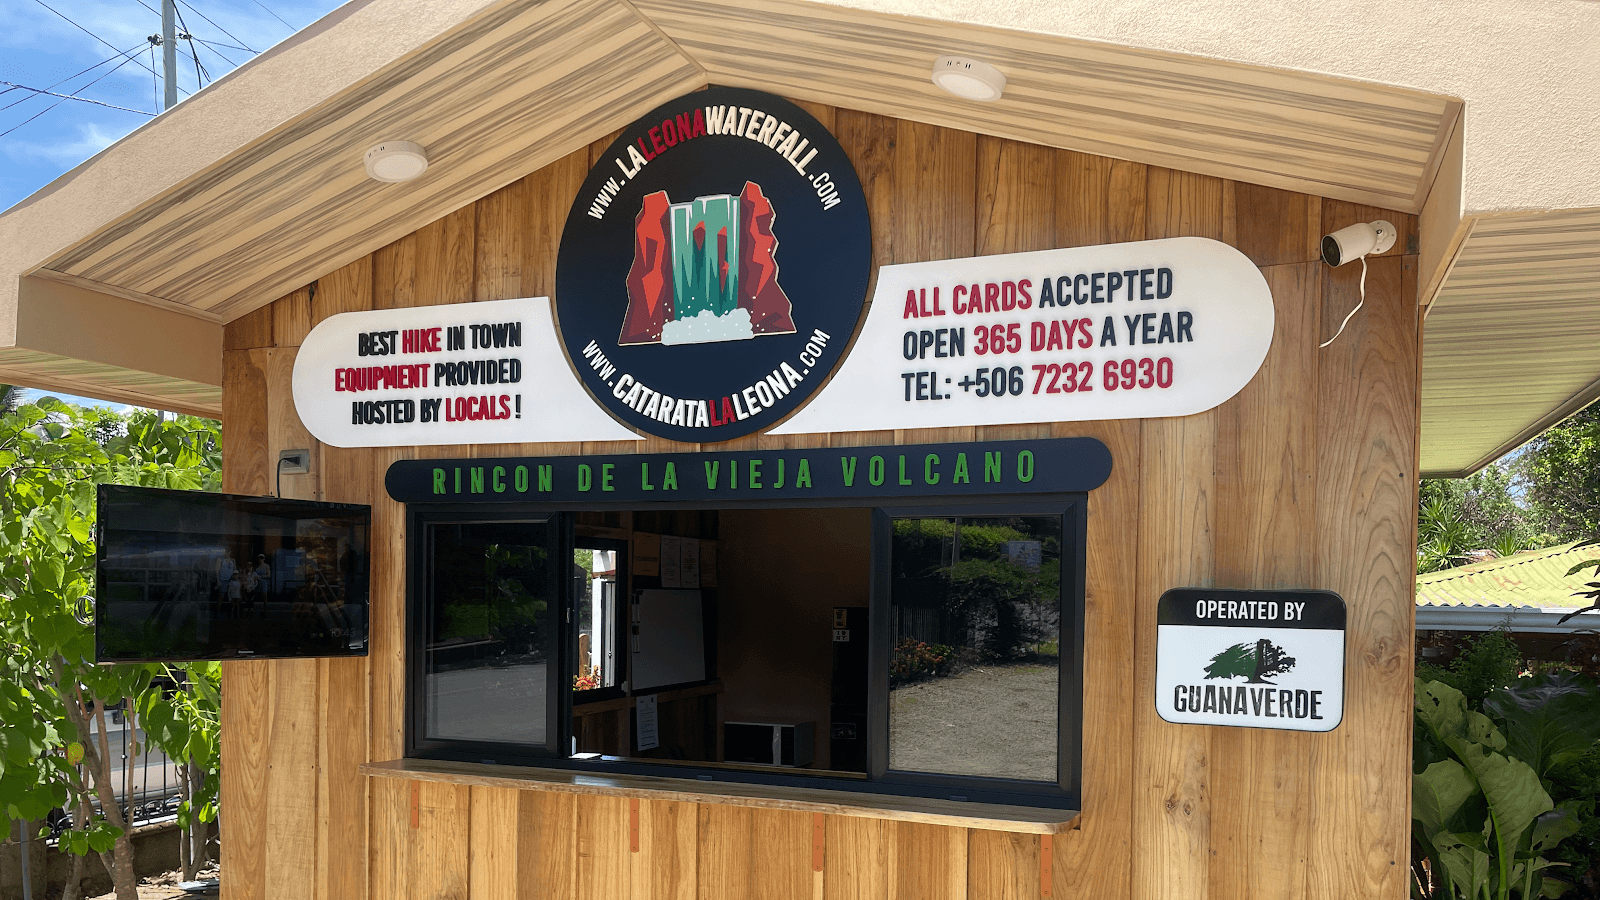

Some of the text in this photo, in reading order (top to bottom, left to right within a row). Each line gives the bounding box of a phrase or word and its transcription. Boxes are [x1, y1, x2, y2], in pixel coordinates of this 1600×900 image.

[903, 267, 1173, 319] ALL CARDS ACCEPTED
[358, 321, 522, 357] BEST HIKE IN TOWN
[903, 311, 1194, 360] OPEN 365 DAYS A YEAR
[334, 358, 522, 393] EQUIPMENT PROVIDED
[901, 356, 1174, 402] TEL: +506 7232 6930
[351, 399, 416, 425] HOSTED
[420, 398, 443, 423] BY
[445, 395, 511, 422] LOCALS
[432, 450, 1035, 495] RINCON DE LA VIEJA VOLCANO
[1195, 600, 1306, 621] OPERATED BY
[1173, 684, 1324, 720] GUANAVERDE
